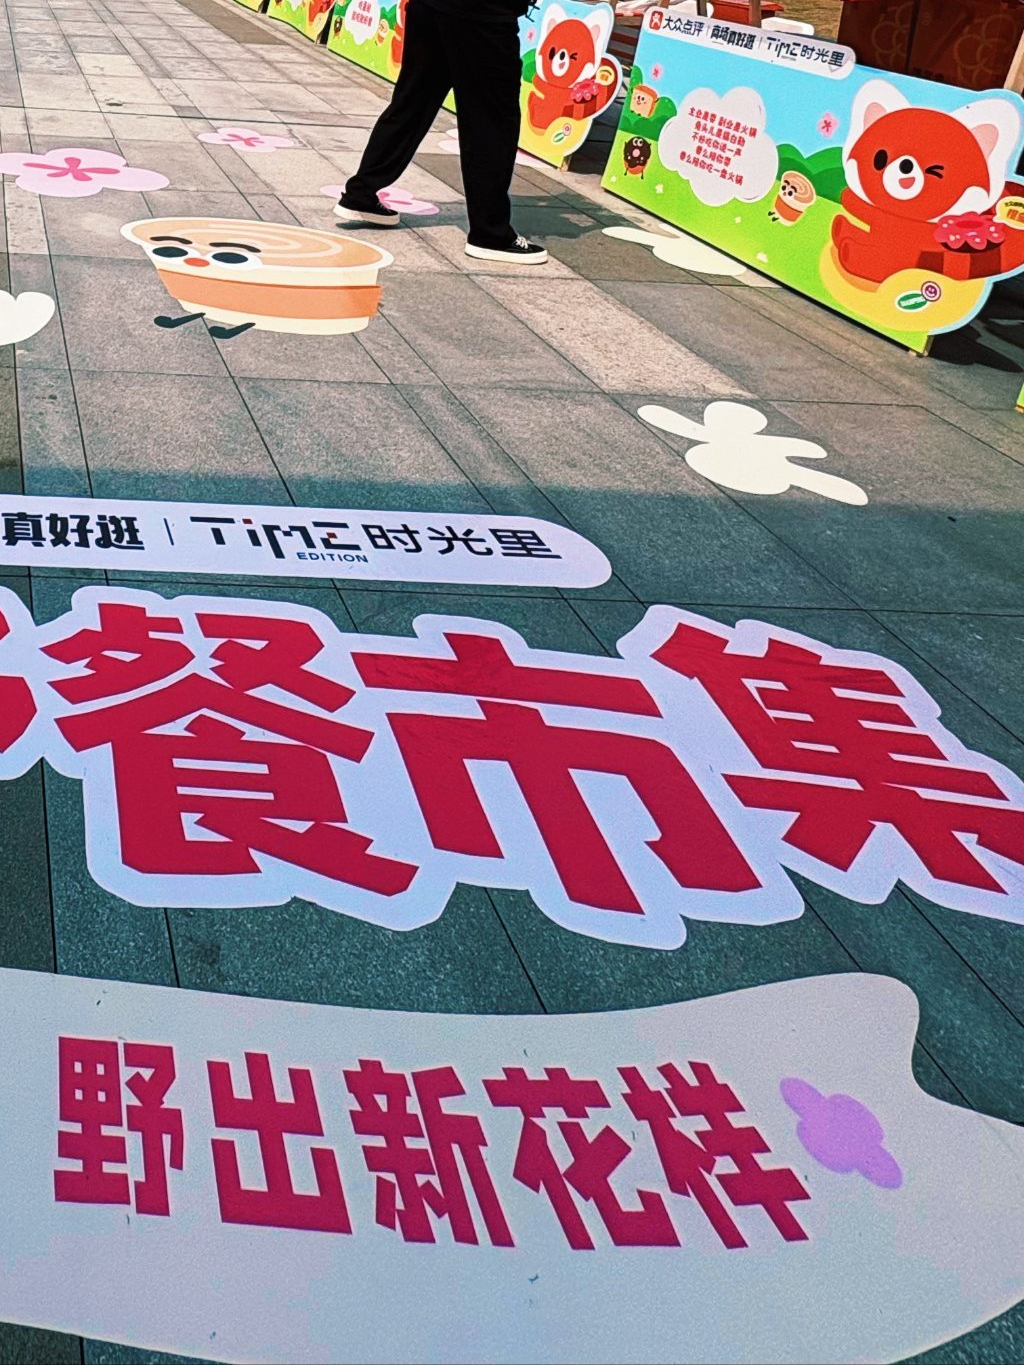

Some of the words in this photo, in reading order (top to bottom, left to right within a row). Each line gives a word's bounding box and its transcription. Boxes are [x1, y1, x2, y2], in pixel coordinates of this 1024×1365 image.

[663, 15, 705, 36] 大众点评
[710, 24, 756, 50] 商场真好逛
[800, 44, 846, 68] 时光里
[296, 552, 369, 563] EDITION
[361, 523, 563, 560] 时光里
[53, 1038, 810, 1248] 野出新花样
